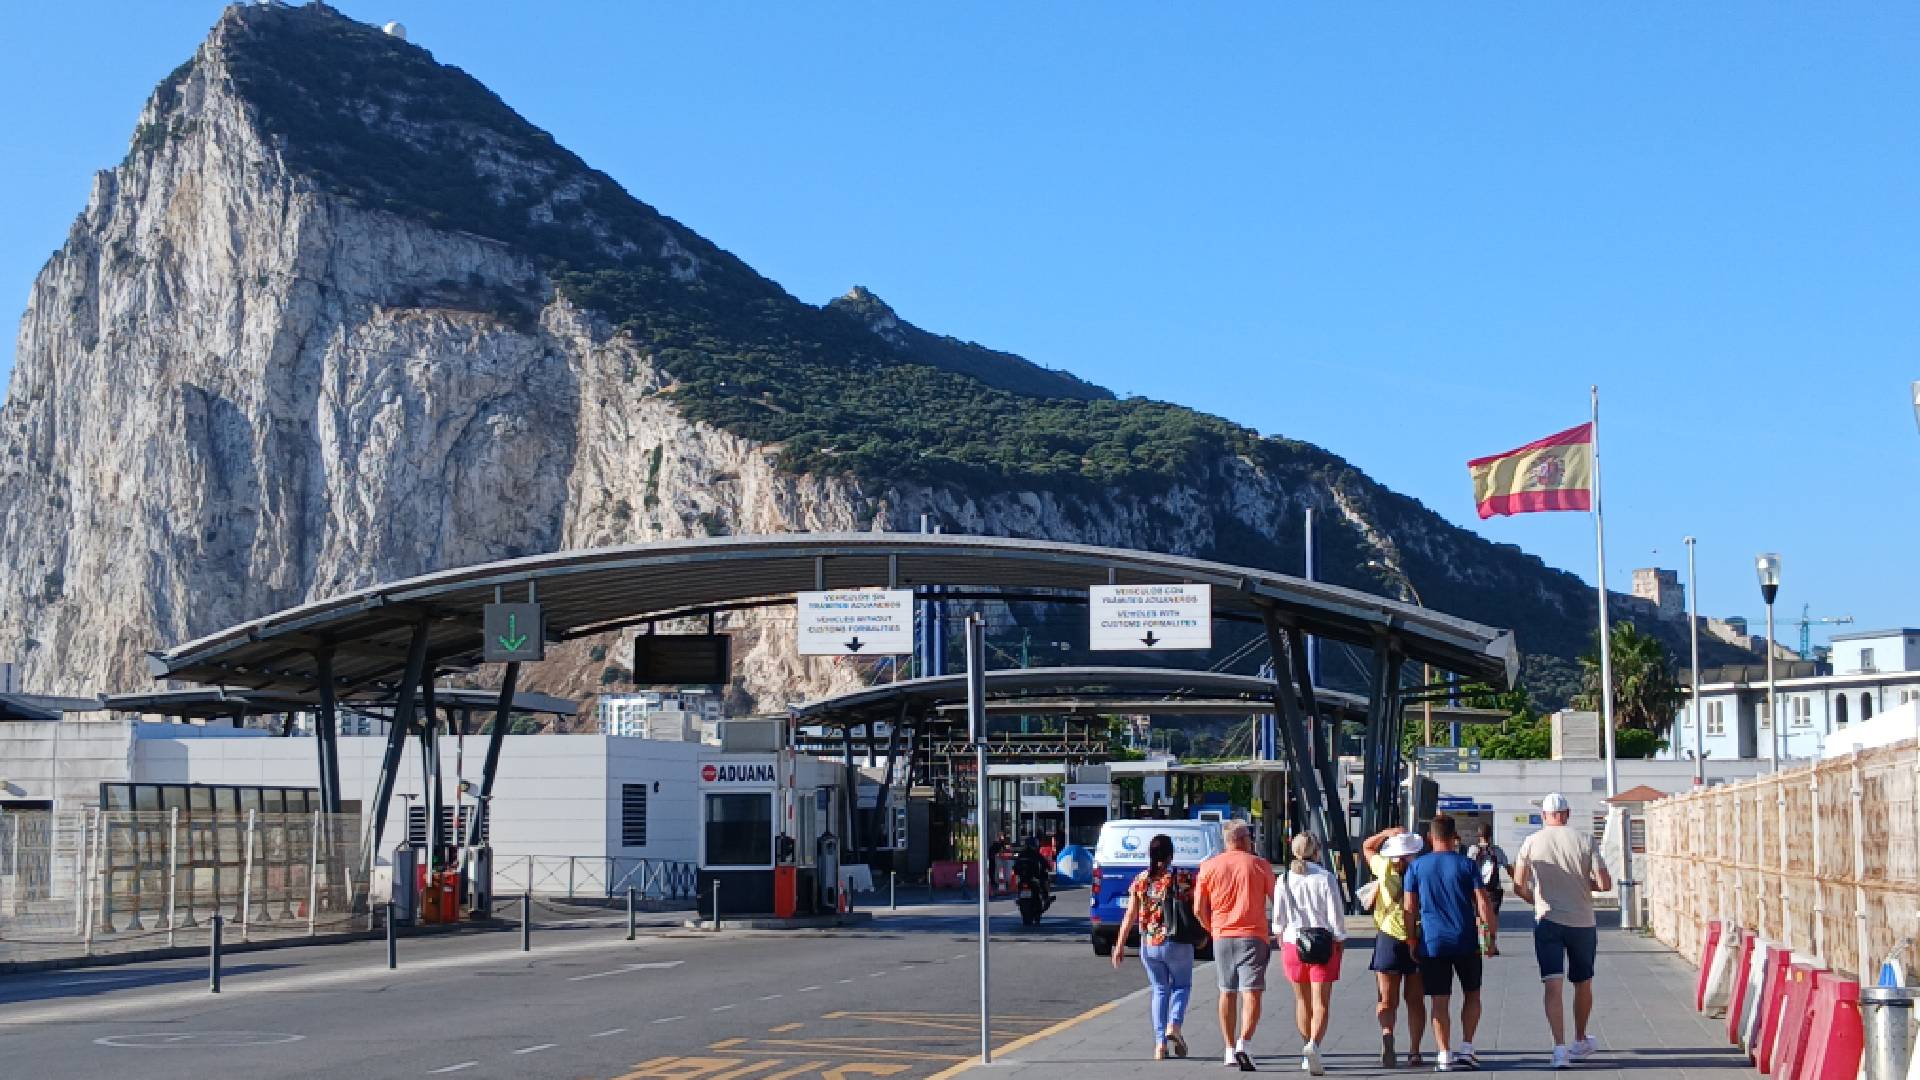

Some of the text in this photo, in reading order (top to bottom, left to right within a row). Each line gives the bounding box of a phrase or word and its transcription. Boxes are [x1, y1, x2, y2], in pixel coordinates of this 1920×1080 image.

[1117, 609, 1180, 617] VEHICLES WITH
[816, 615, 855, 623] VEHICLES
[1101, 619, 1197, 628] CUSTOMS FORMALITIES
[808, 624, 901, 633] CUSTOMS FORMALITIES
[717, 764, 776, 782] ADUANA
